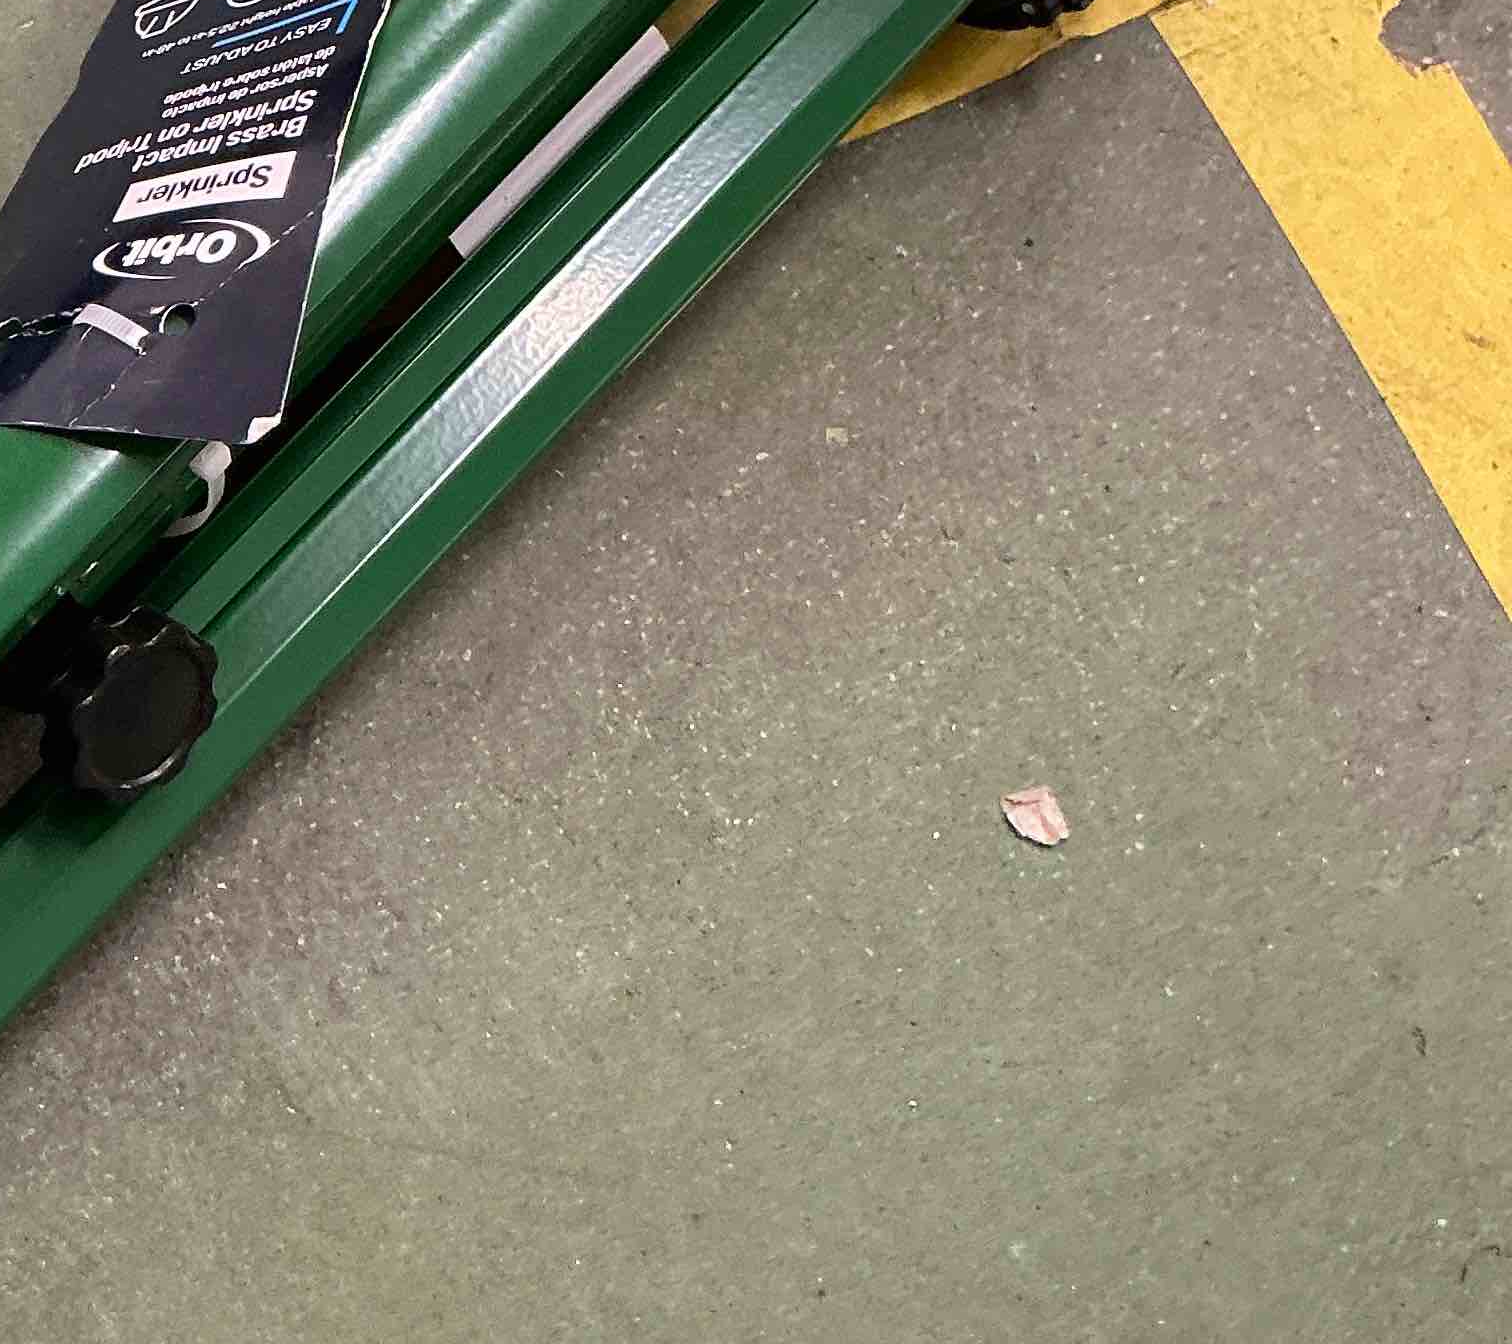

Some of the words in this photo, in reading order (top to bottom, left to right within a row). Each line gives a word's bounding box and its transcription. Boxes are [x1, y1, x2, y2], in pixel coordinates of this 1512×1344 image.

[240, 6, 281, 27] height
[175, 35, 191, 47] to
[251, 36, 279, 53] TO
[280, 17, 333, 46] EASY
[179, 46, 252, 75] ADJUST
[314, 45, 337, 61] de
[222, 65, 271, 86] sobre
[254, 62, 330, 92] Aspersor
[161, 90, 228, 120] impacto
[227, 85, 250, 101] de
[193, 88, 319, 134] Sprinkler
[156, 122, 193, 144] on
[225, 114, 309, 146] Brass
[73, 131, 154, 175] Tripod
[131, 133, 223, 173] Impact
[135, 162, 274, 205] Sprinkler
[121, 228, 239, 268] Orbit
